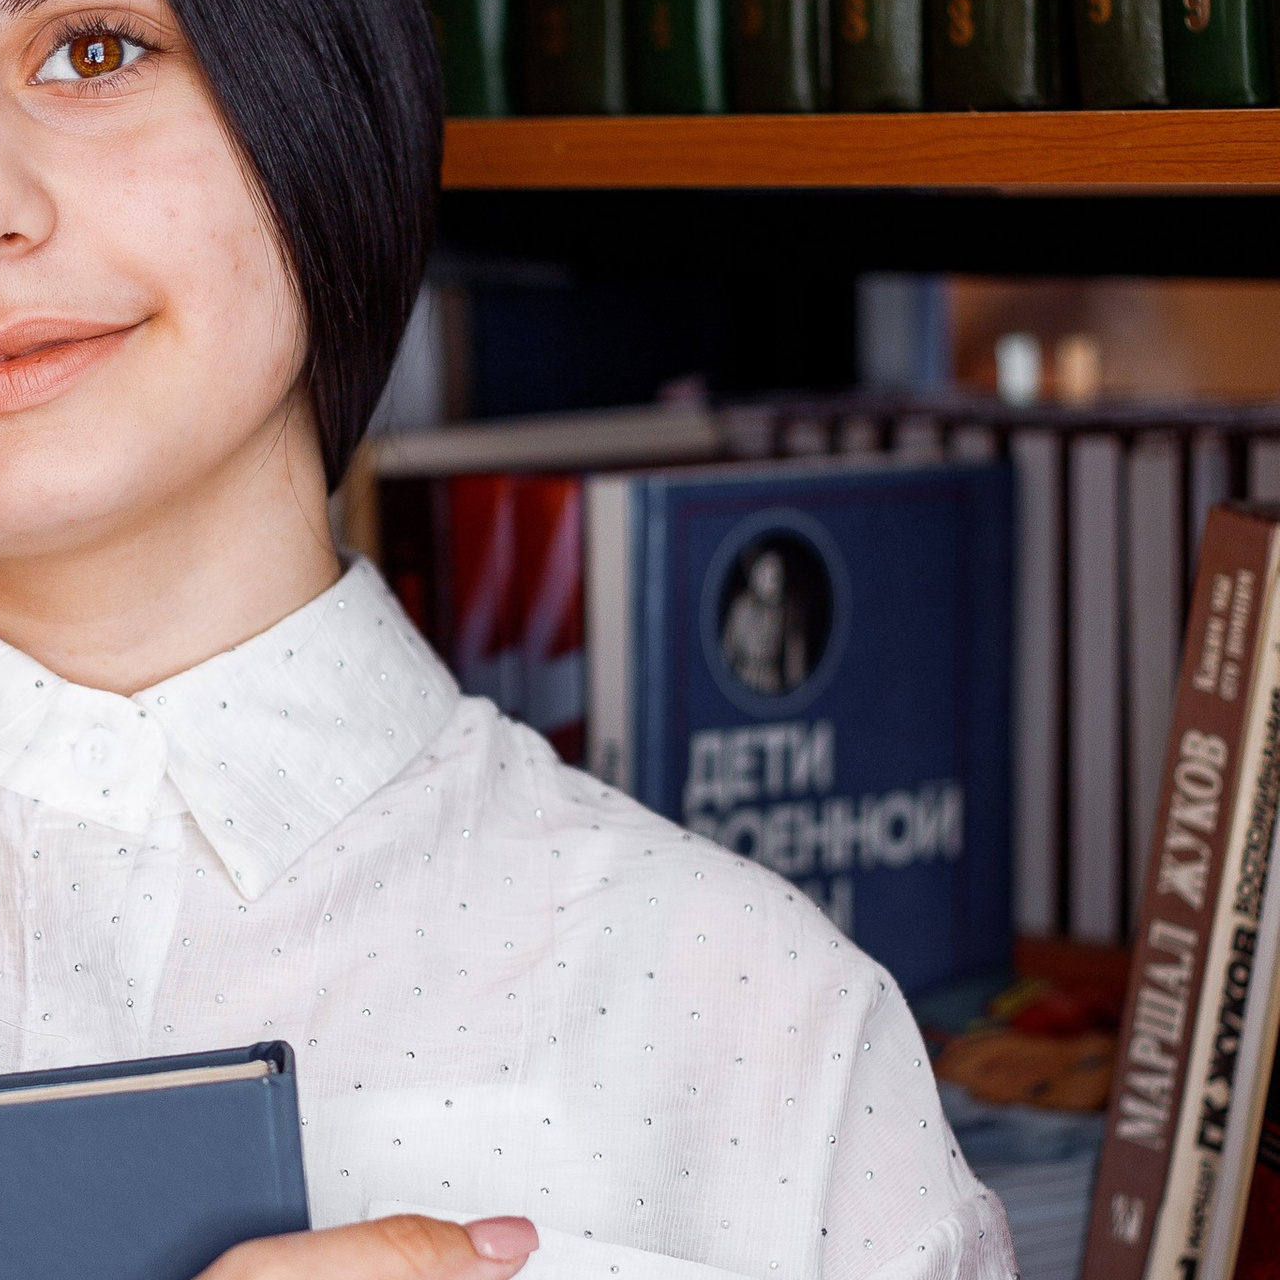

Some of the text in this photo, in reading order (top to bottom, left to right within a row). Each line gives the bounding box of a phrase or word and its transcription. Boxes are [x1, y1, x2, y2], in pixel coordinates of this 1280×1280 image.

[686, 720, 835, 808] ДЕТИ
[1156, 728, 1229, 912] ЖУКОВ
[1116, 919, 1200, 1153] МАРШАЛ
